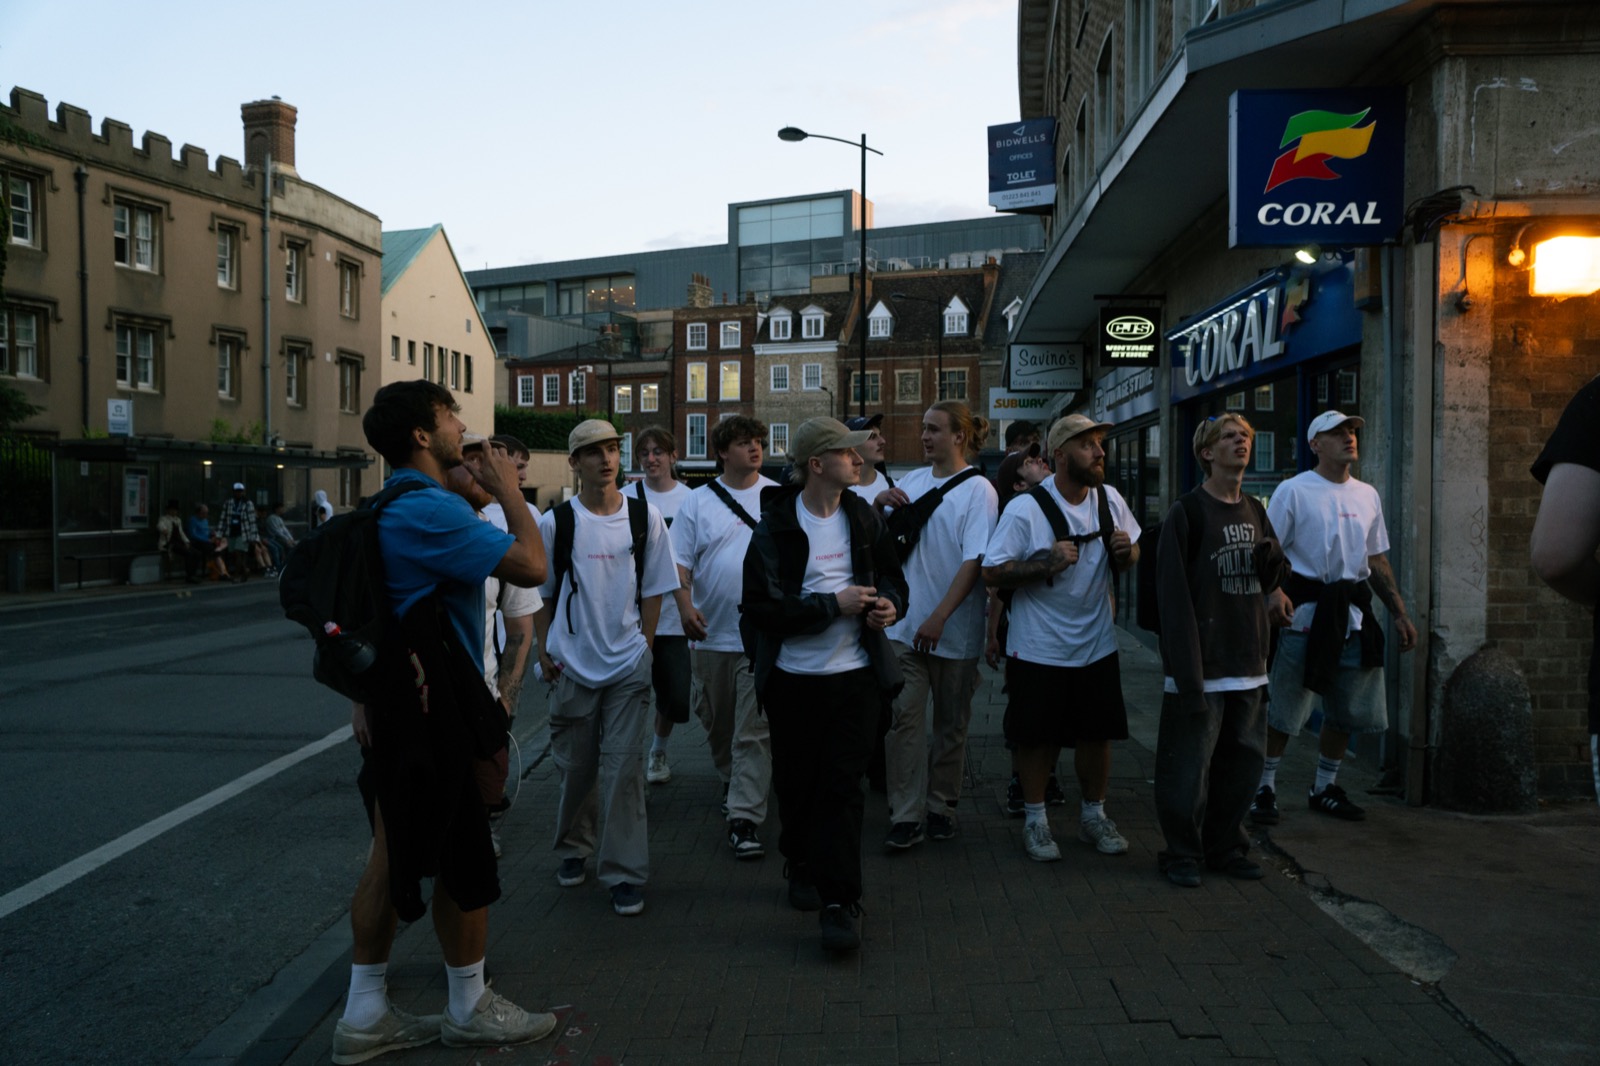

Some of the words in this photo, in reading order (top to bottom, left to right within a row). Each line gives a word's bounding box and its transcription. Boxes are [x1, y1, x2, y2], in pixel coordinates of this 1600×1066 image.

[996, 134, 1046, 148] BIDWELLS
[1009, 152, 1033, 161] OFFICES
[1007, 173, 1019, 181] TO
[1020, 170, 1036, 179] LET
[1257, 202, 1381, 226] CORAL
[1185, 286, 1284, 387] CORAL
[1018, 348, 1077, 367] Savino's
[994, 399, 1046, 408] SUBWAY
[1223, 523, 1255, 544] 1967
[1217, 549, 1241, 577] POLO
[1222, 577, 1243, 595] RALPH
